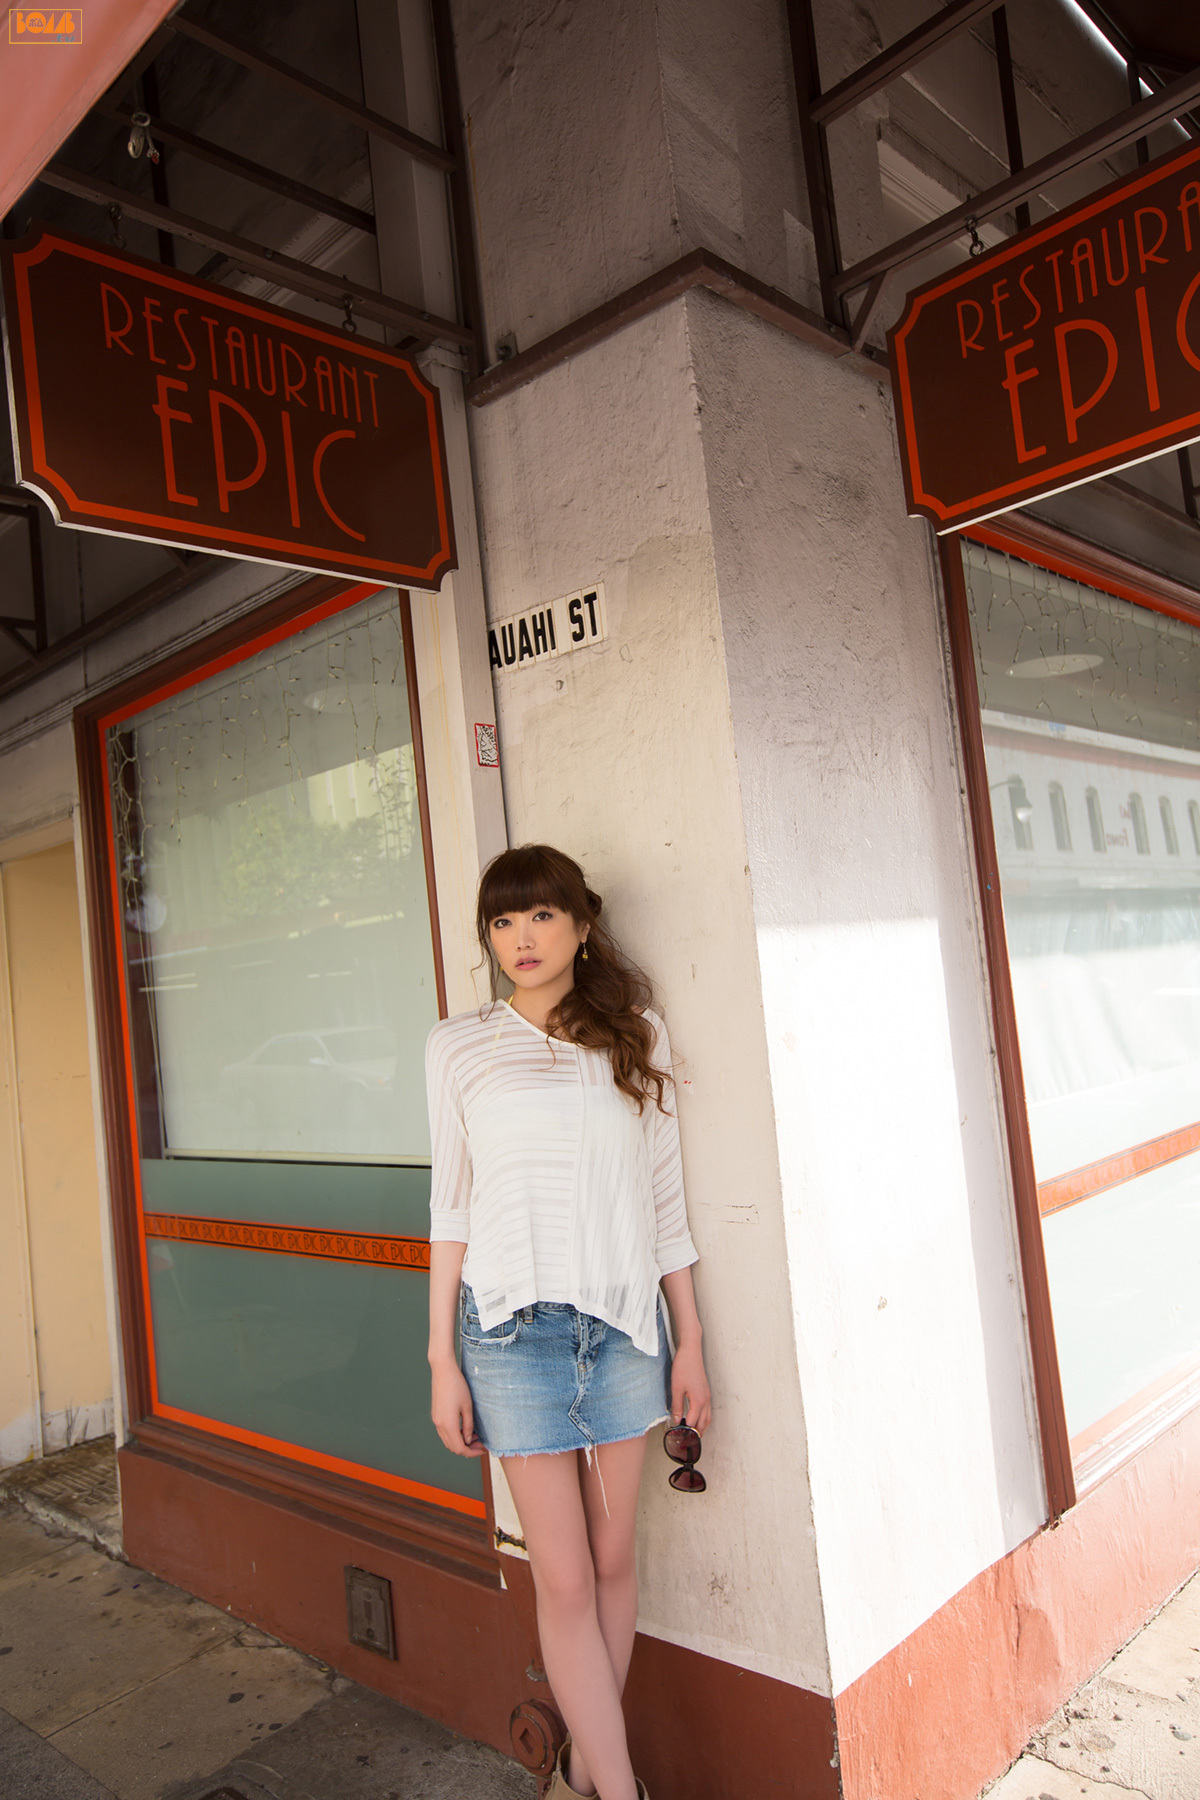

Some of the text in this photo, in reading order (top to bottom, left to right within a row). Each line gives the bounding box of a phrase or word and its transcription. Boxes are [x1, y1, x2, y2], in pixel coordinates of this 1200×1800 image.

[100, 281, 379, 429] RESTAURANT
[153, 374, 366, 543] EPIC
[568, 591, 598, 643] ST
